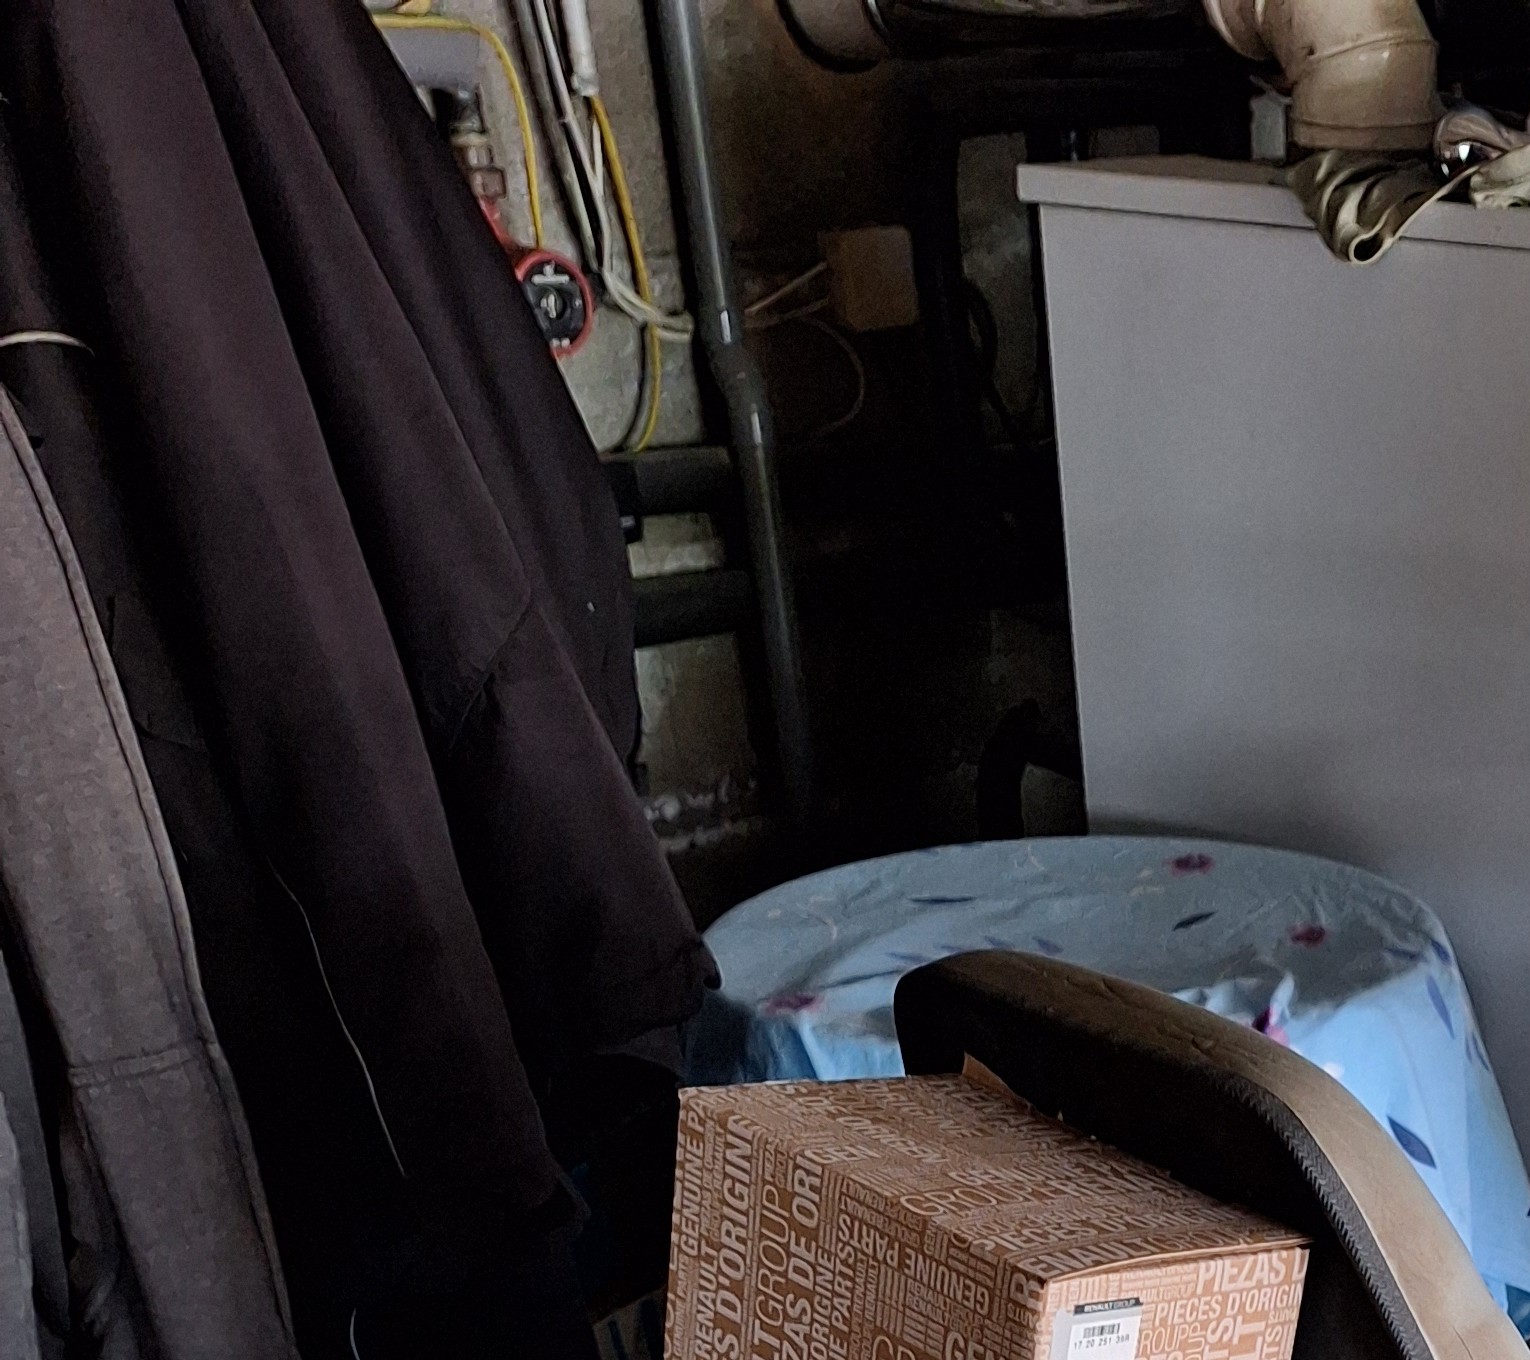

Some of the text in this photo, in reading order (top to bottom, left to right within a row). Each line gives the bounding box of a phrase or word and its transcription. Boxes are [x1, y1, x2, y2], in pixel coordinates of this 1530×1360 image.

[679, 1134, 704, 1258] GENUINE
[787, 1228, 817, 1291] DE
[837, 1210, 900, 1270] PARTS
[830, 1238, 856, 1332] PARTS
[903, 1245, 990, 1318] GENUINE
[1194, 1250, 1289, 1295] PIEZAS
[1154, 1293, 1223, 1327] PIECES
[1073, 1341, 1083, 1350] 17
[1085, 1338, 1095, 1348] 20
[1098, 1336, 1112, 1347] 251
